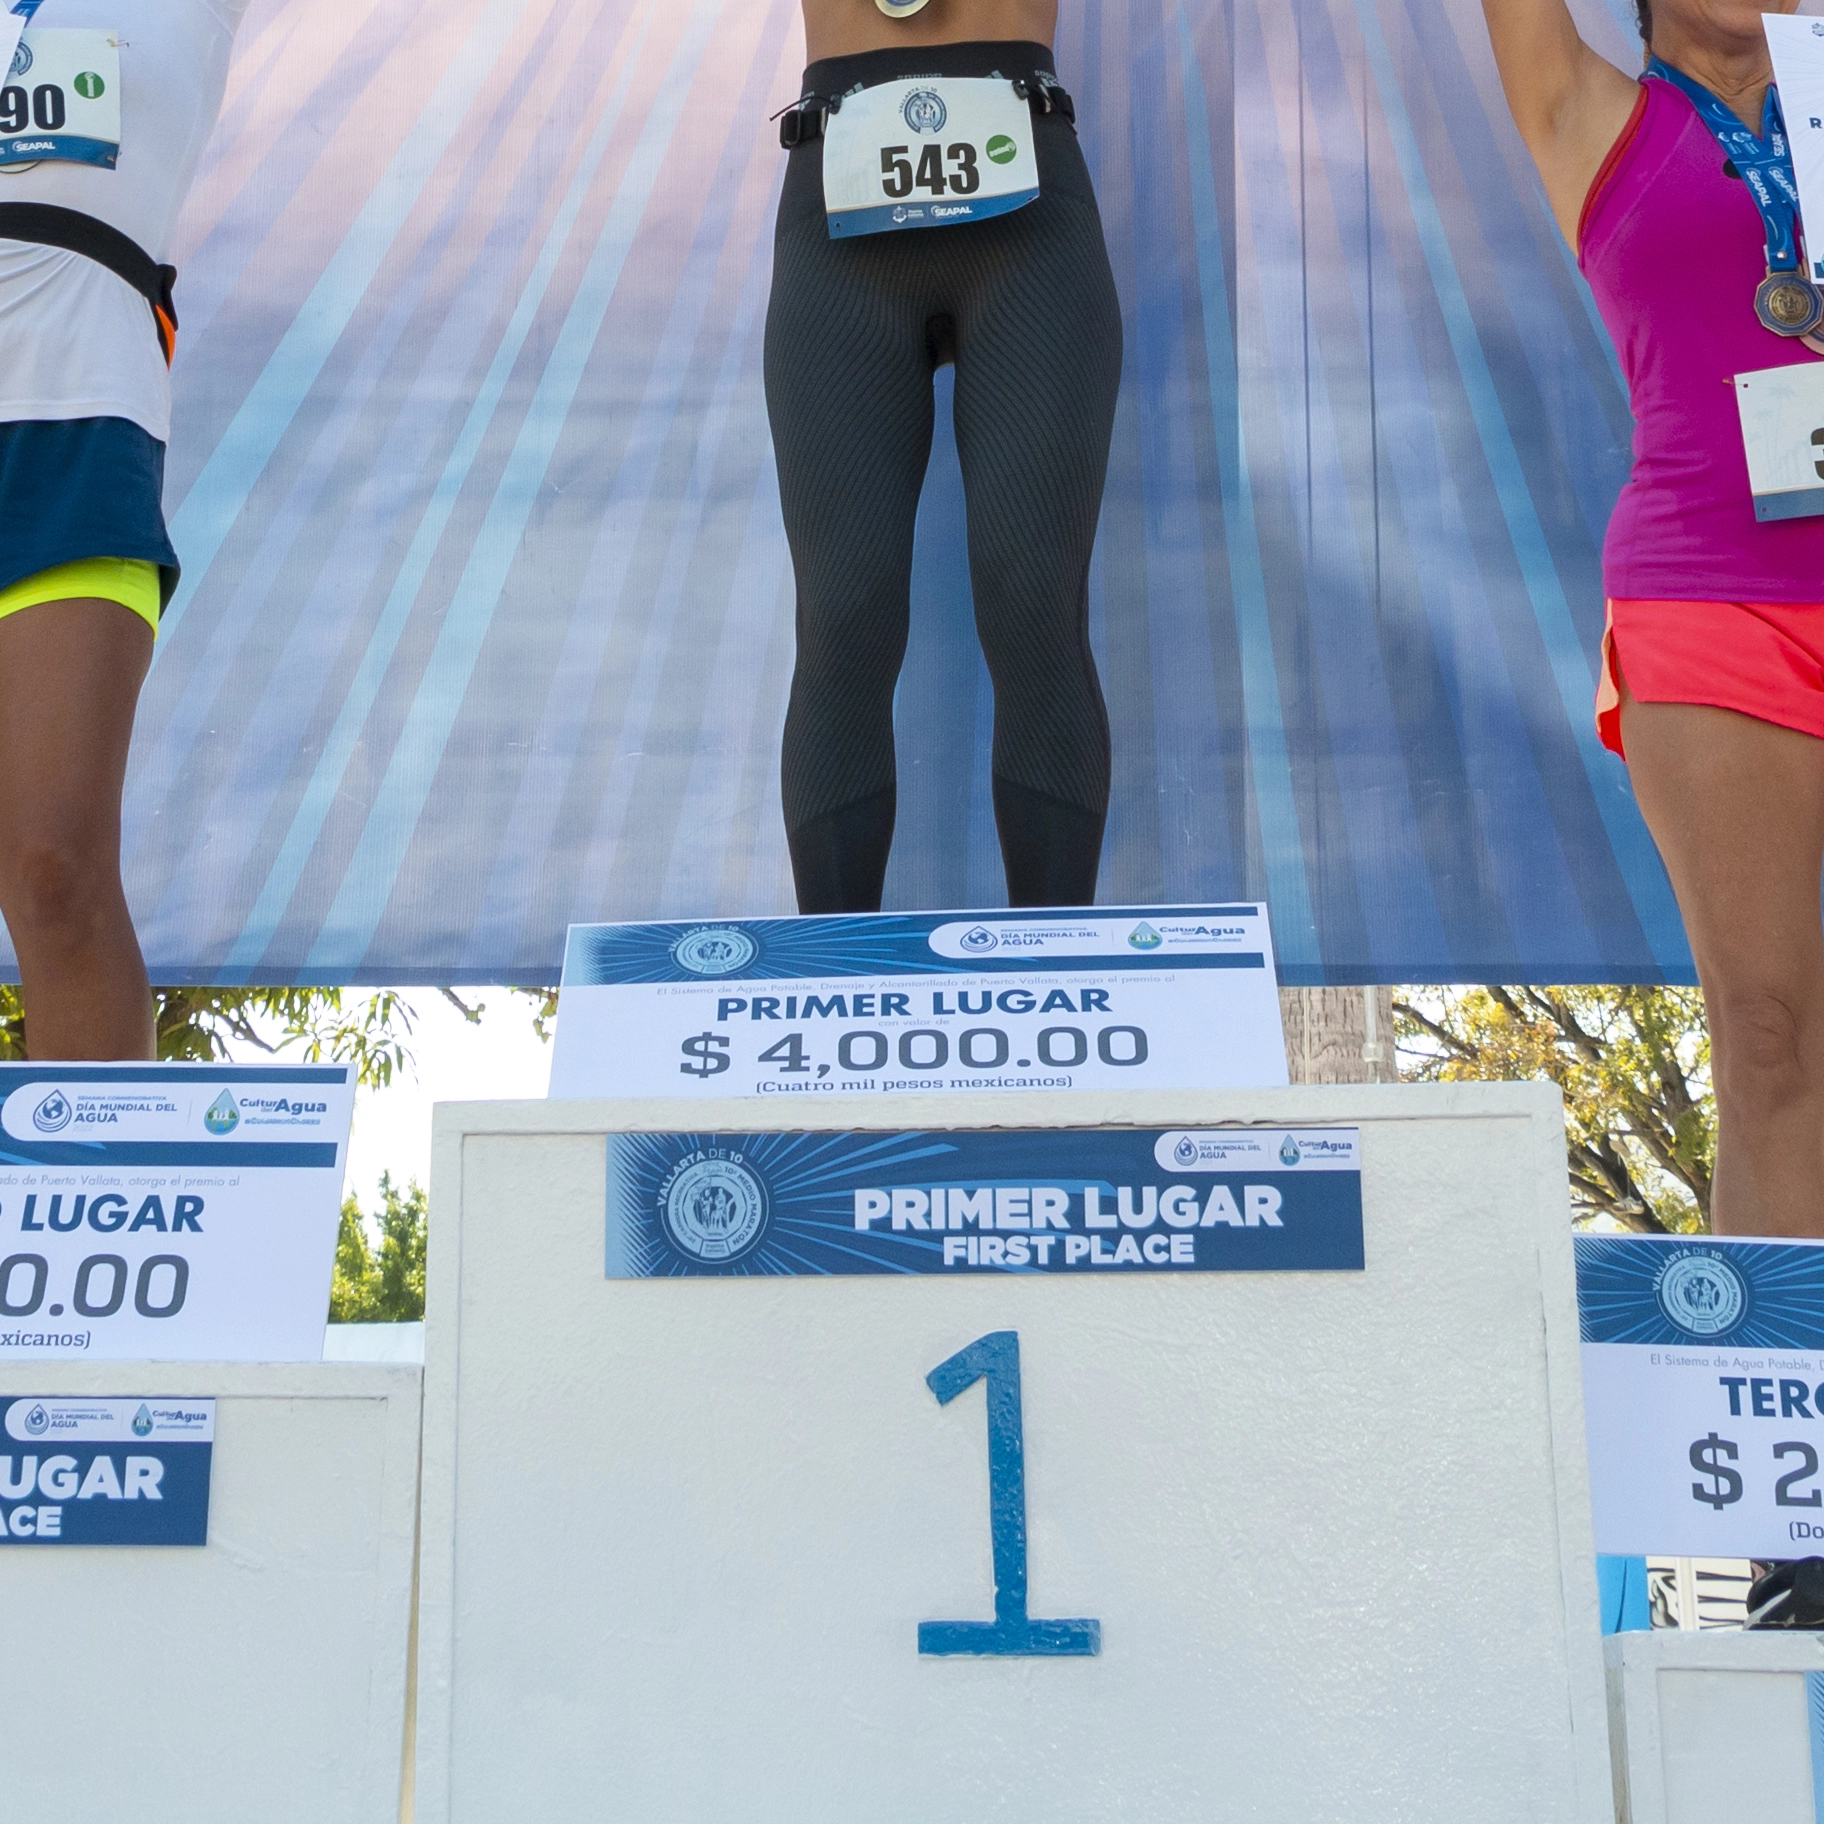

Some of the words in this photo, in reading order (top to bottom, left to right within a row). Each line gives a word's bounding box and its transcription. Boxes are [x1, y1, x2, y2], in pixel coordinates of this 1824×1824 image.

[16, 140, 56, 151] SEAPAL
[880, 142, 981, 199] 543
[1746, 169, 1772, 208] SEAPAL
[934, 205, 973, 217] SEAPAL
[717, 992, 912, 1023] PRIMER
[933, 988, 1114, 1016] LUGAR
[679, 1031, 731, 1079] $
[757, 1025, 1150, 1081] 4,000.00
[756, 1080, 836, 1095] (Cuatro
[841, 1078, 877, 1092] mil
[882, 1079, 944, 1094] pesos
[950, 1074, 1074, 1090] mexicanos)
[74, 1112, 119, 1124] AGUA
[100, 1102, 153, 1113] MUNDIAL
[155, 1103, 178, 1112] DEL
[22, 1175, 37, 1187] de
[40, 1176, 77, 1187] Puerto
[128, 1178, 168, 1189] otorga
[184, 1177, 225, 1189] premio
[656, 1150, 707, 1207] VALLARTA
[708, 1147, 728, 1160] DE
[729, 1151, 744, 1165] 10
[20, 1193, 206, 1233] LUGAR
[854, 1186, 1072, 1231] PRIMER
[1083, 1184, 1285, 1229] LUGAR
[942, 1233, 1055, 1267] FIRST
[1063, 1232, 1196, 1266] PLACE
[1664, 1355, 1711, 1368] Sistema
[1714, 1357, 1729, 1368] de
[1732, 1357, 1765, 1371] Agua
[1768, 1358, 1816, 1372] Potable,
[1688, 1432, 1744, 1511] $
[918, 1330, 1102, 1657] 1
